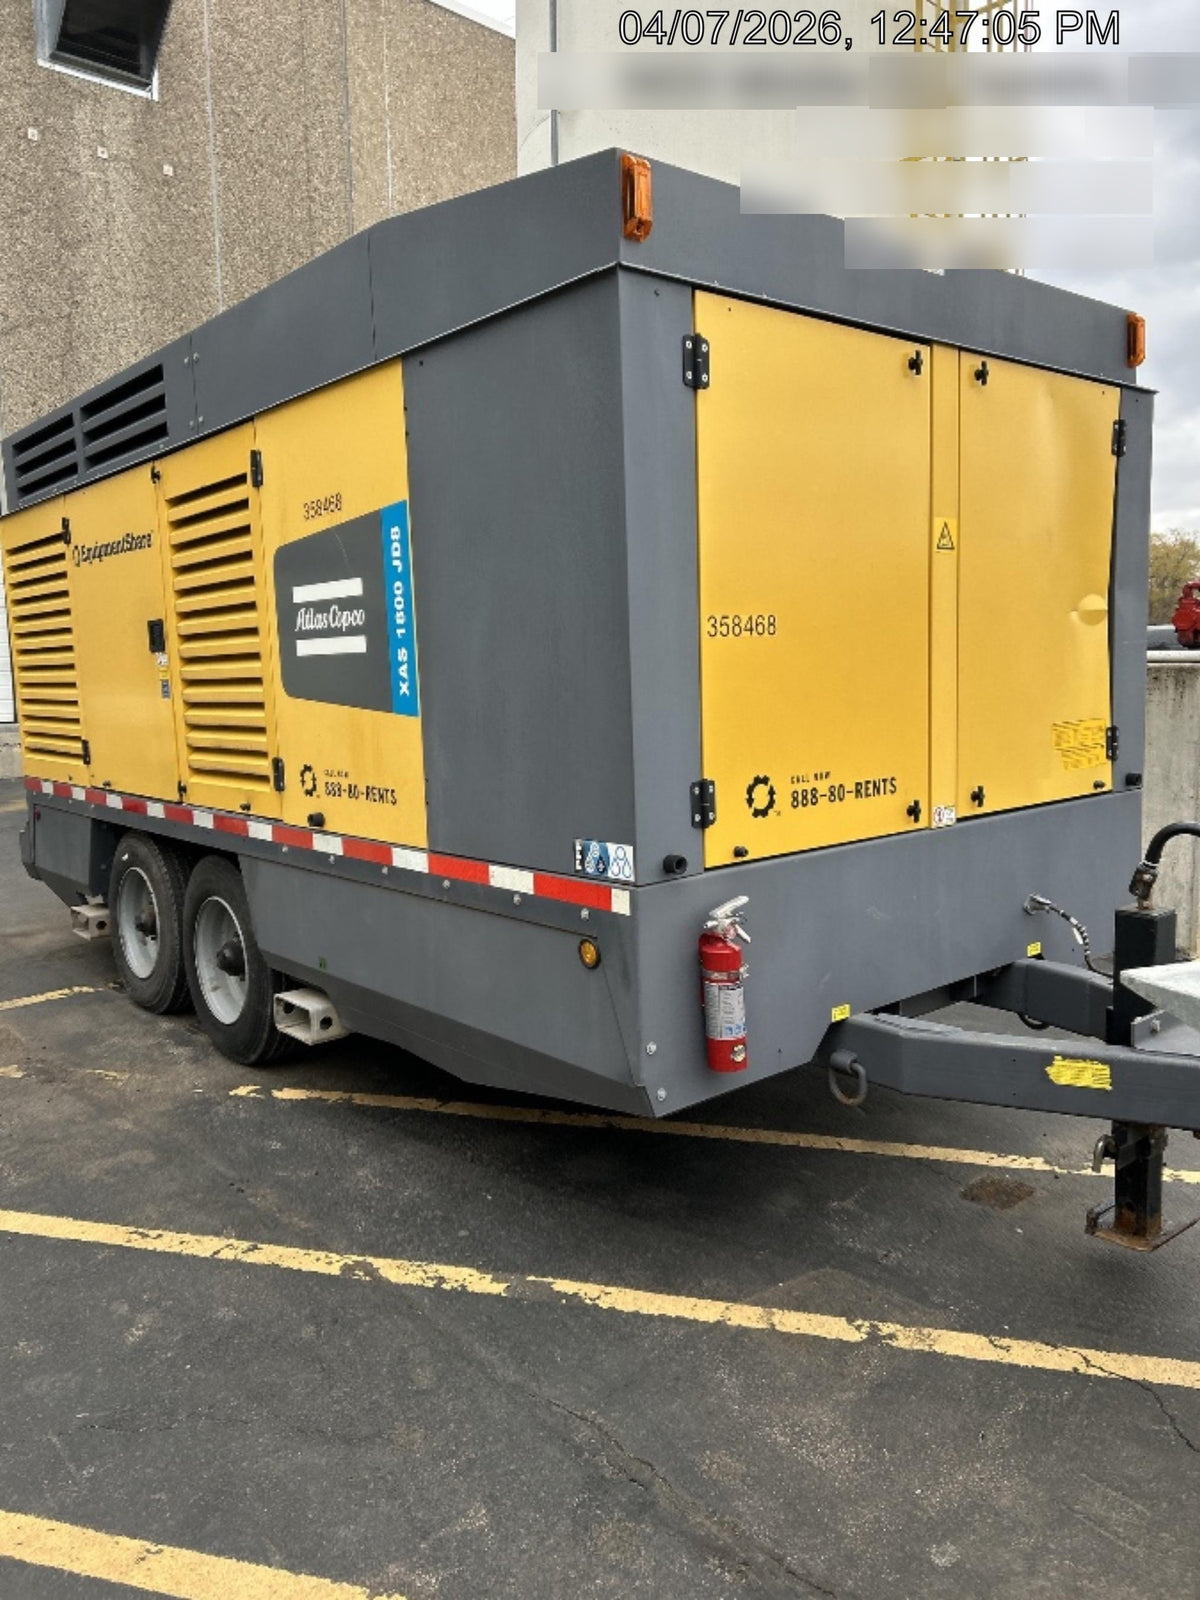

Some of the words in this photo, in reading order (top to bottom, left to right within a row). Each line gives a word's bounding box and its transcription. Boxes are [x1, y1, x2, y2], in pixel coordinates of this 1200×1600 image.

[303, 491, 342, 520] 358468
[81, 532, 152, 564] EquipmentShare
[295, 607, 329, 632] Atlas
[328, 604, 366, 632] Copco
[393, 581, 407, 639] 1800
[706, 614, 777, 638] 358468
[397, 647, 410, 696] XAS
[324, 781, 398, 806] 888-80-RENTS
[790, 777, 898, 809] 888-80-RENTS
